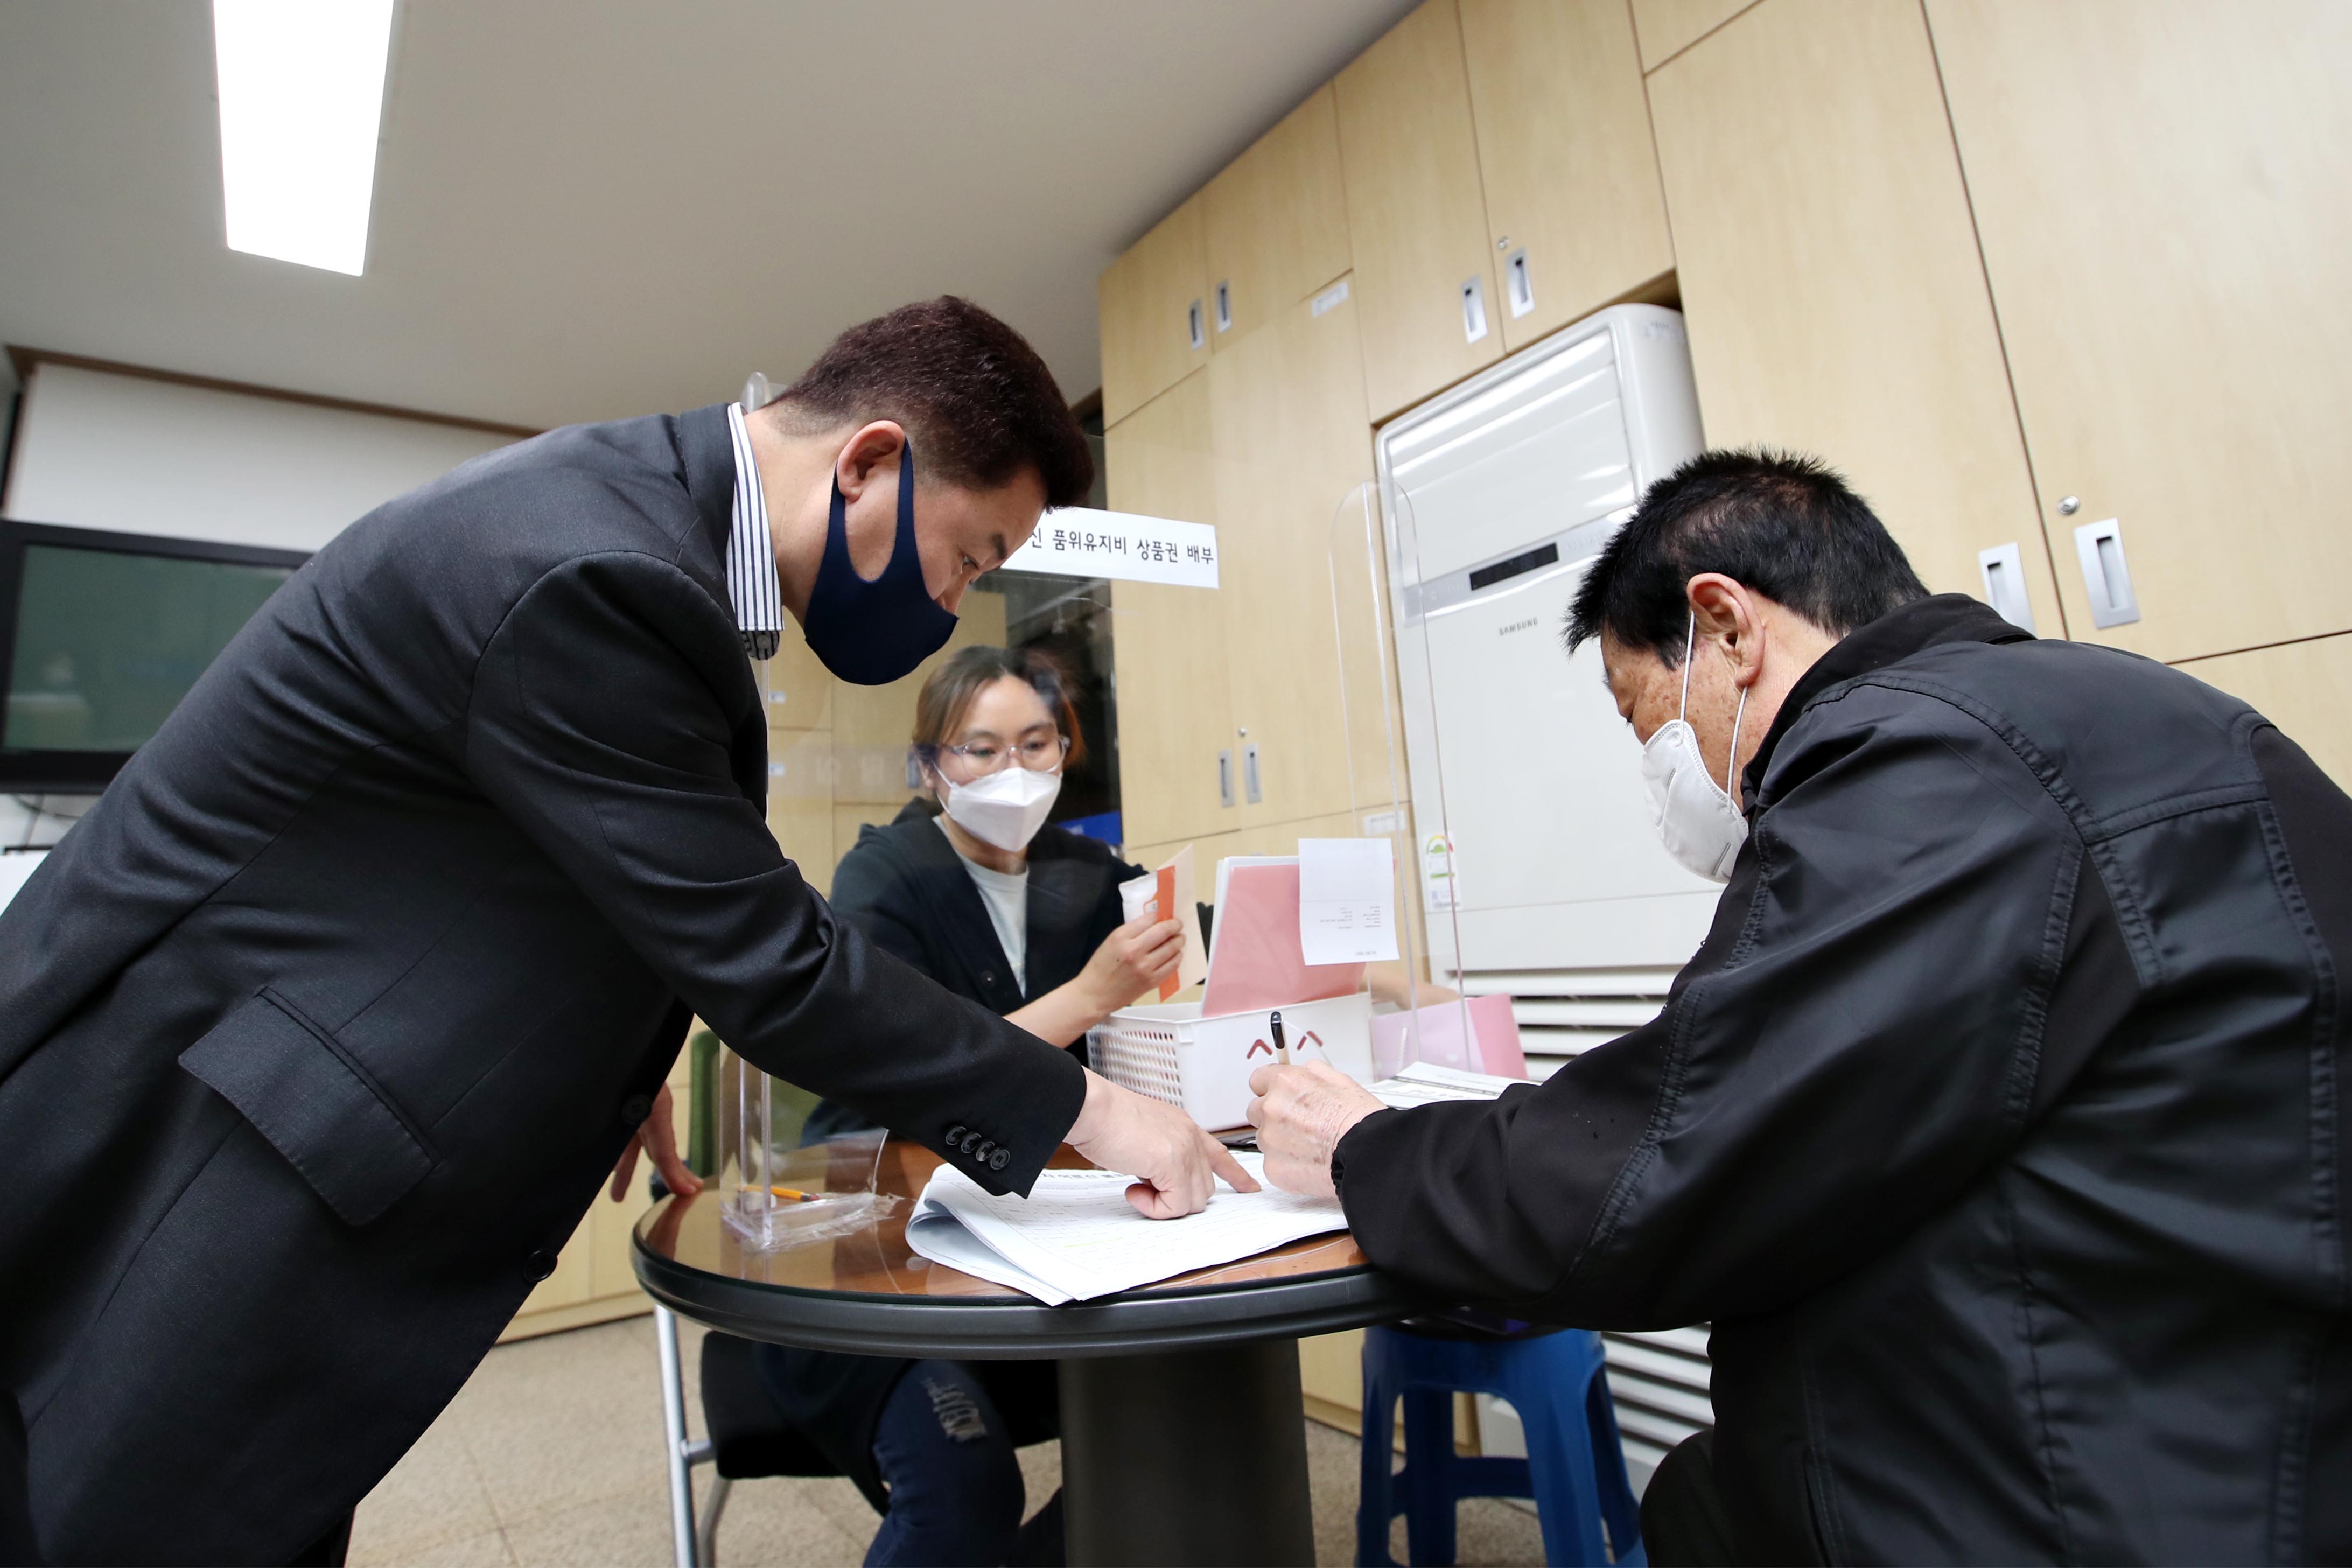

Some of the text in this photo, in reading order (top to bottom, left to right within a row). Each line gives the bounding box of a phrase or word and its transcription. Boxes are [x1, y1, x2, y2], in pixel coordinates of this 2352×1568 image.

[1053, 529, 1126, 555] 품위유지비
[1137, 538, 1178, 563] 상품권
[1187, 544, 1214, 564] 배부
[1499, 617, 1538, 636] SAMSUNG
